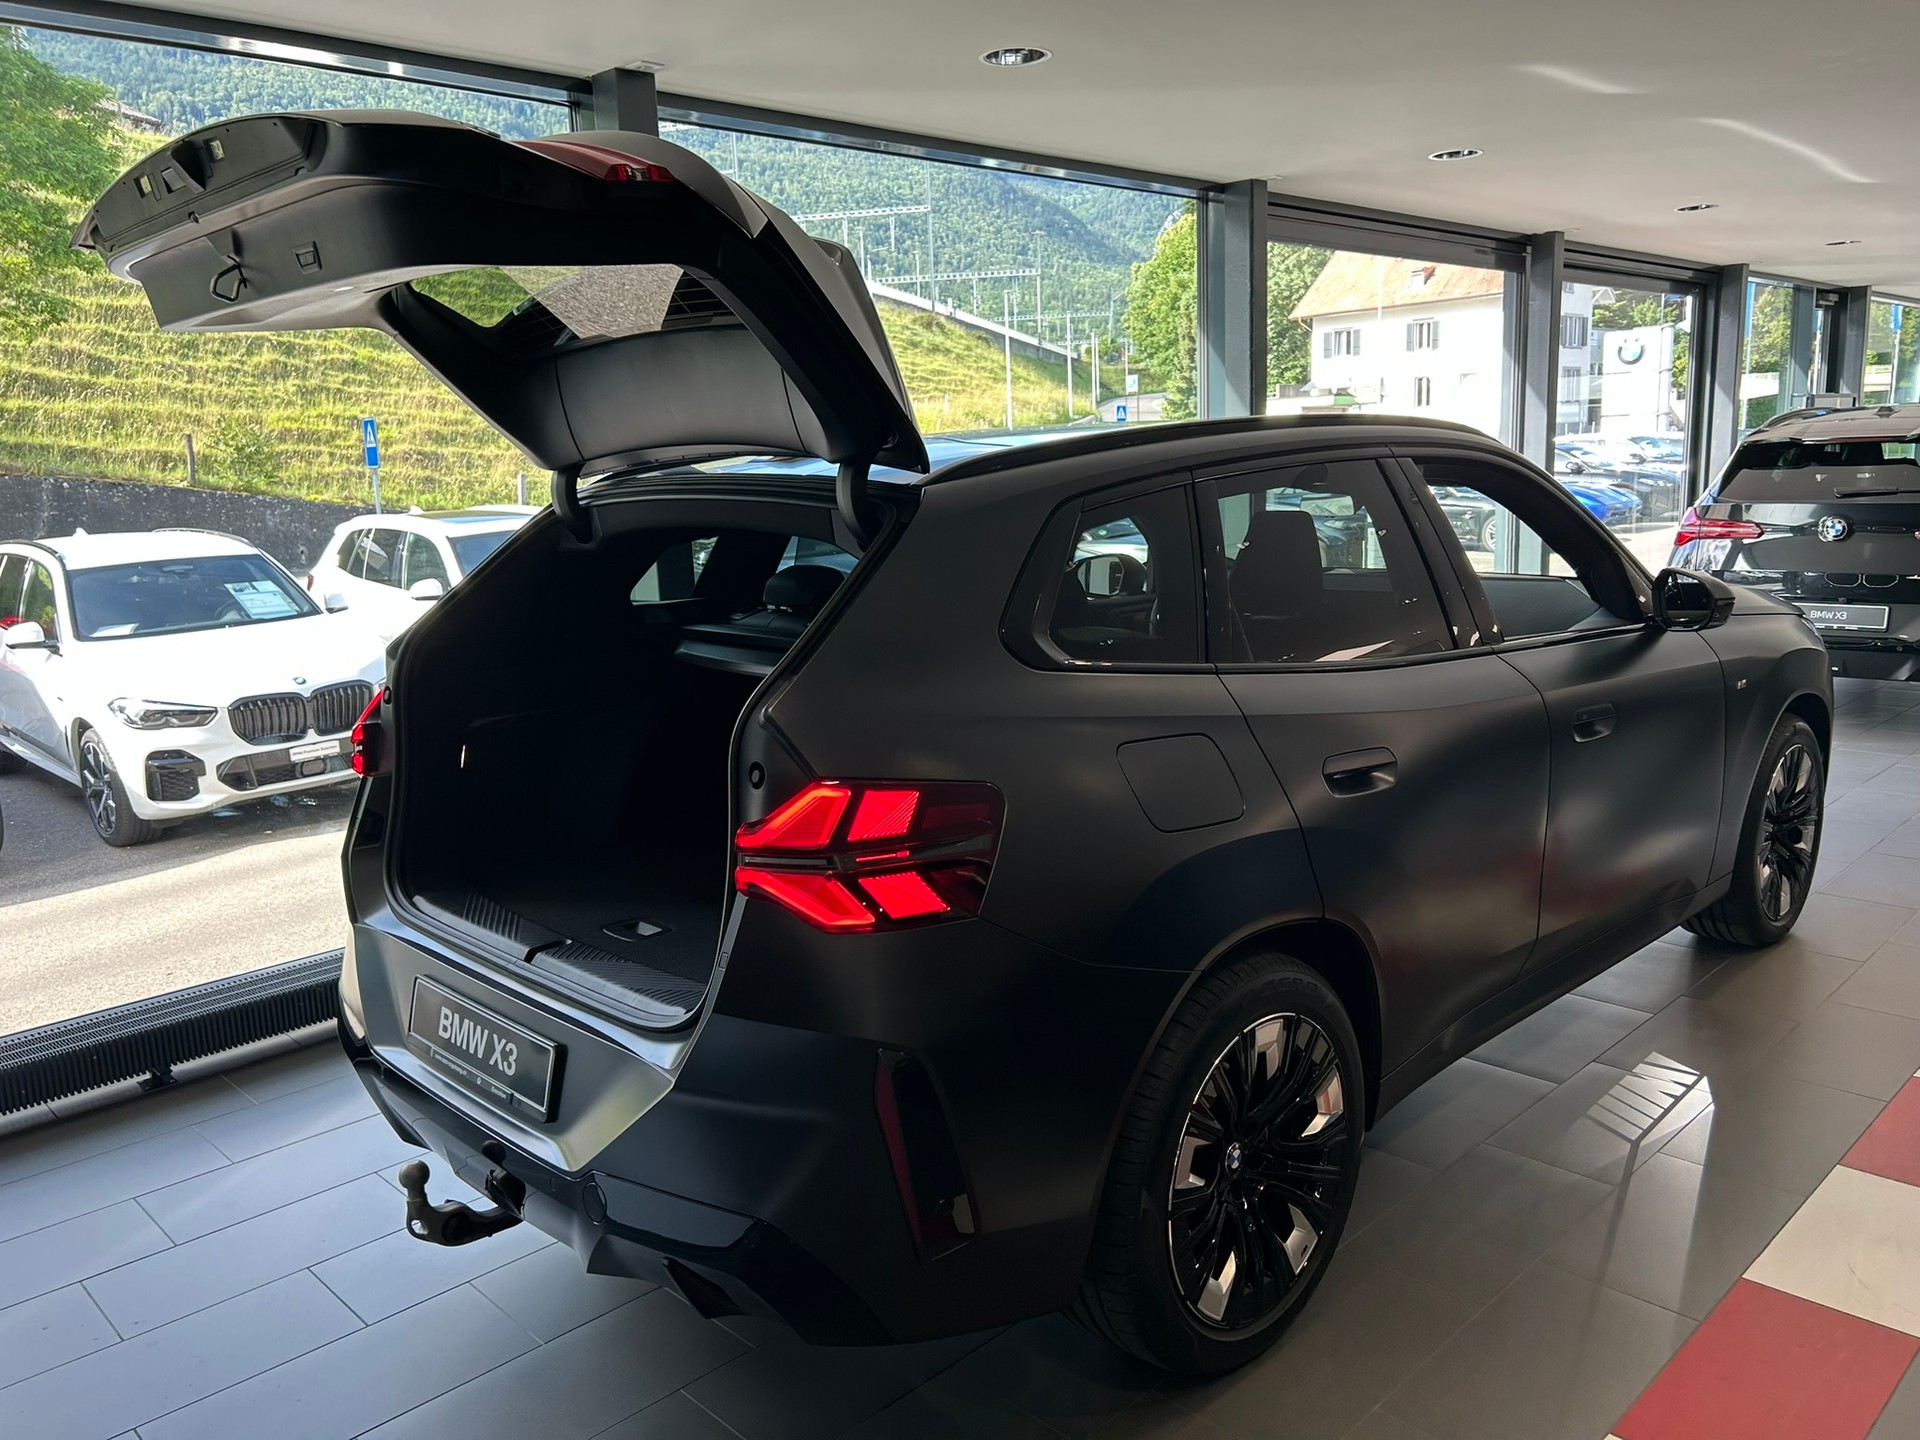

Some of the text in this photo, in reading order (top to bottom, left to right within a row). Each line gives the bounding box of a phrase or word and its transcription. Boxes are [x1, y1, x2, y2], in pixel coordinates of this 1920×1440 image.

[1810, 610, 1848, 621] BMW X3
[438, 1006, 489, 1060] BMW
[488, 1033, 518, 1077] X3
